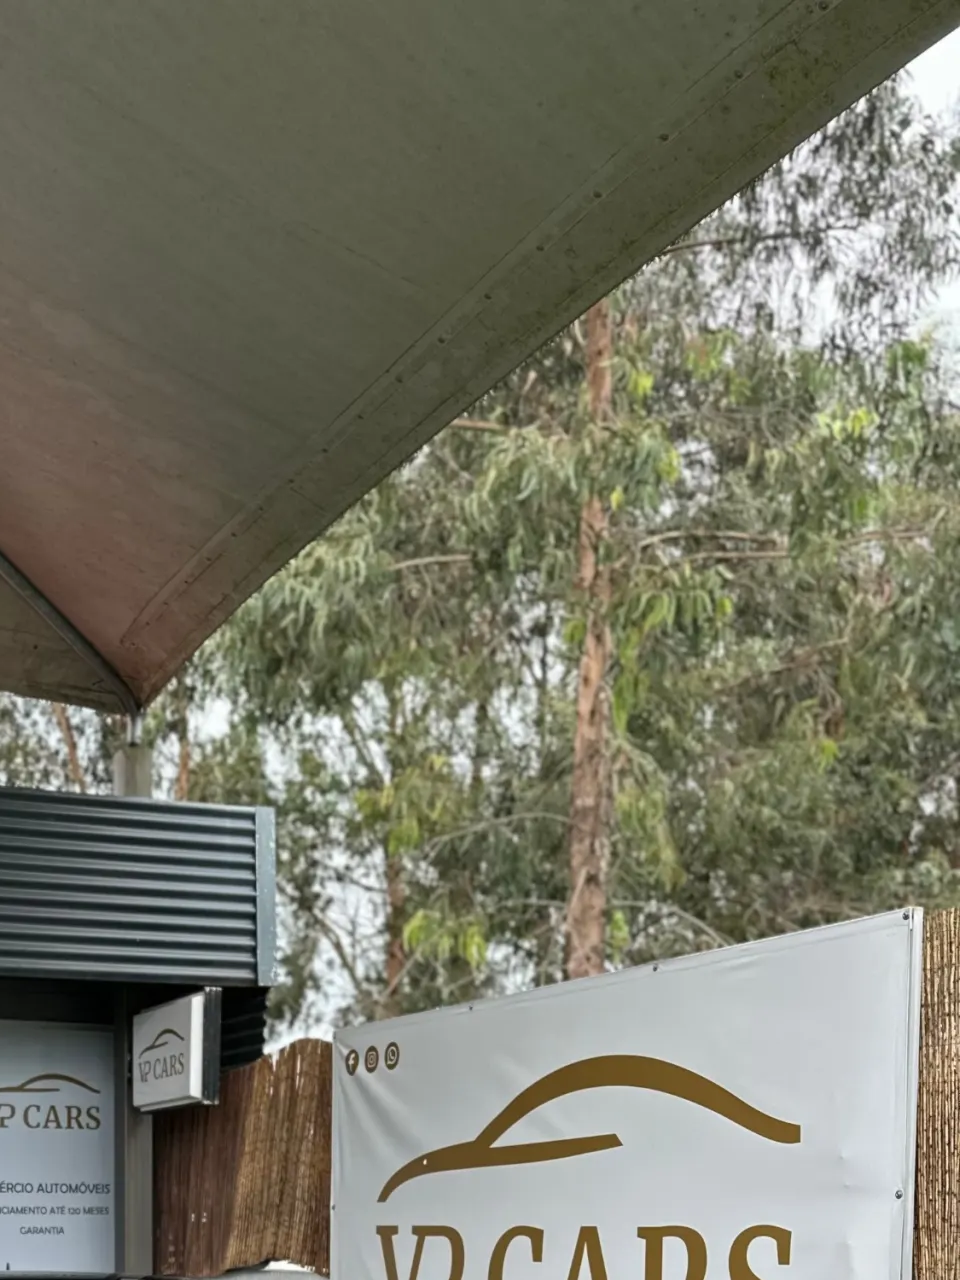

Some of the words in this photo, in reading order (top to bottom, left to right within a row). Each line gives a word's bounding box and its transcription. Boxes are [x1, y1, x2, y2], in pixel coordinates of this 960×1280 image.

[138, 1061, 152, 1083] VP
[153, 1053, 185, 1081] CARS
[22, 1104, 101, 1130] CARS
[36, 1182, 111, 1195] AUTOMÓVEIS
[49, 1204, 66, 1216] ATÉ
[68, 1207, 81, 1216] 120
[82, 1206, 110, 1216] MESES
[20, 1226, 65, 1236] GARANTIA
